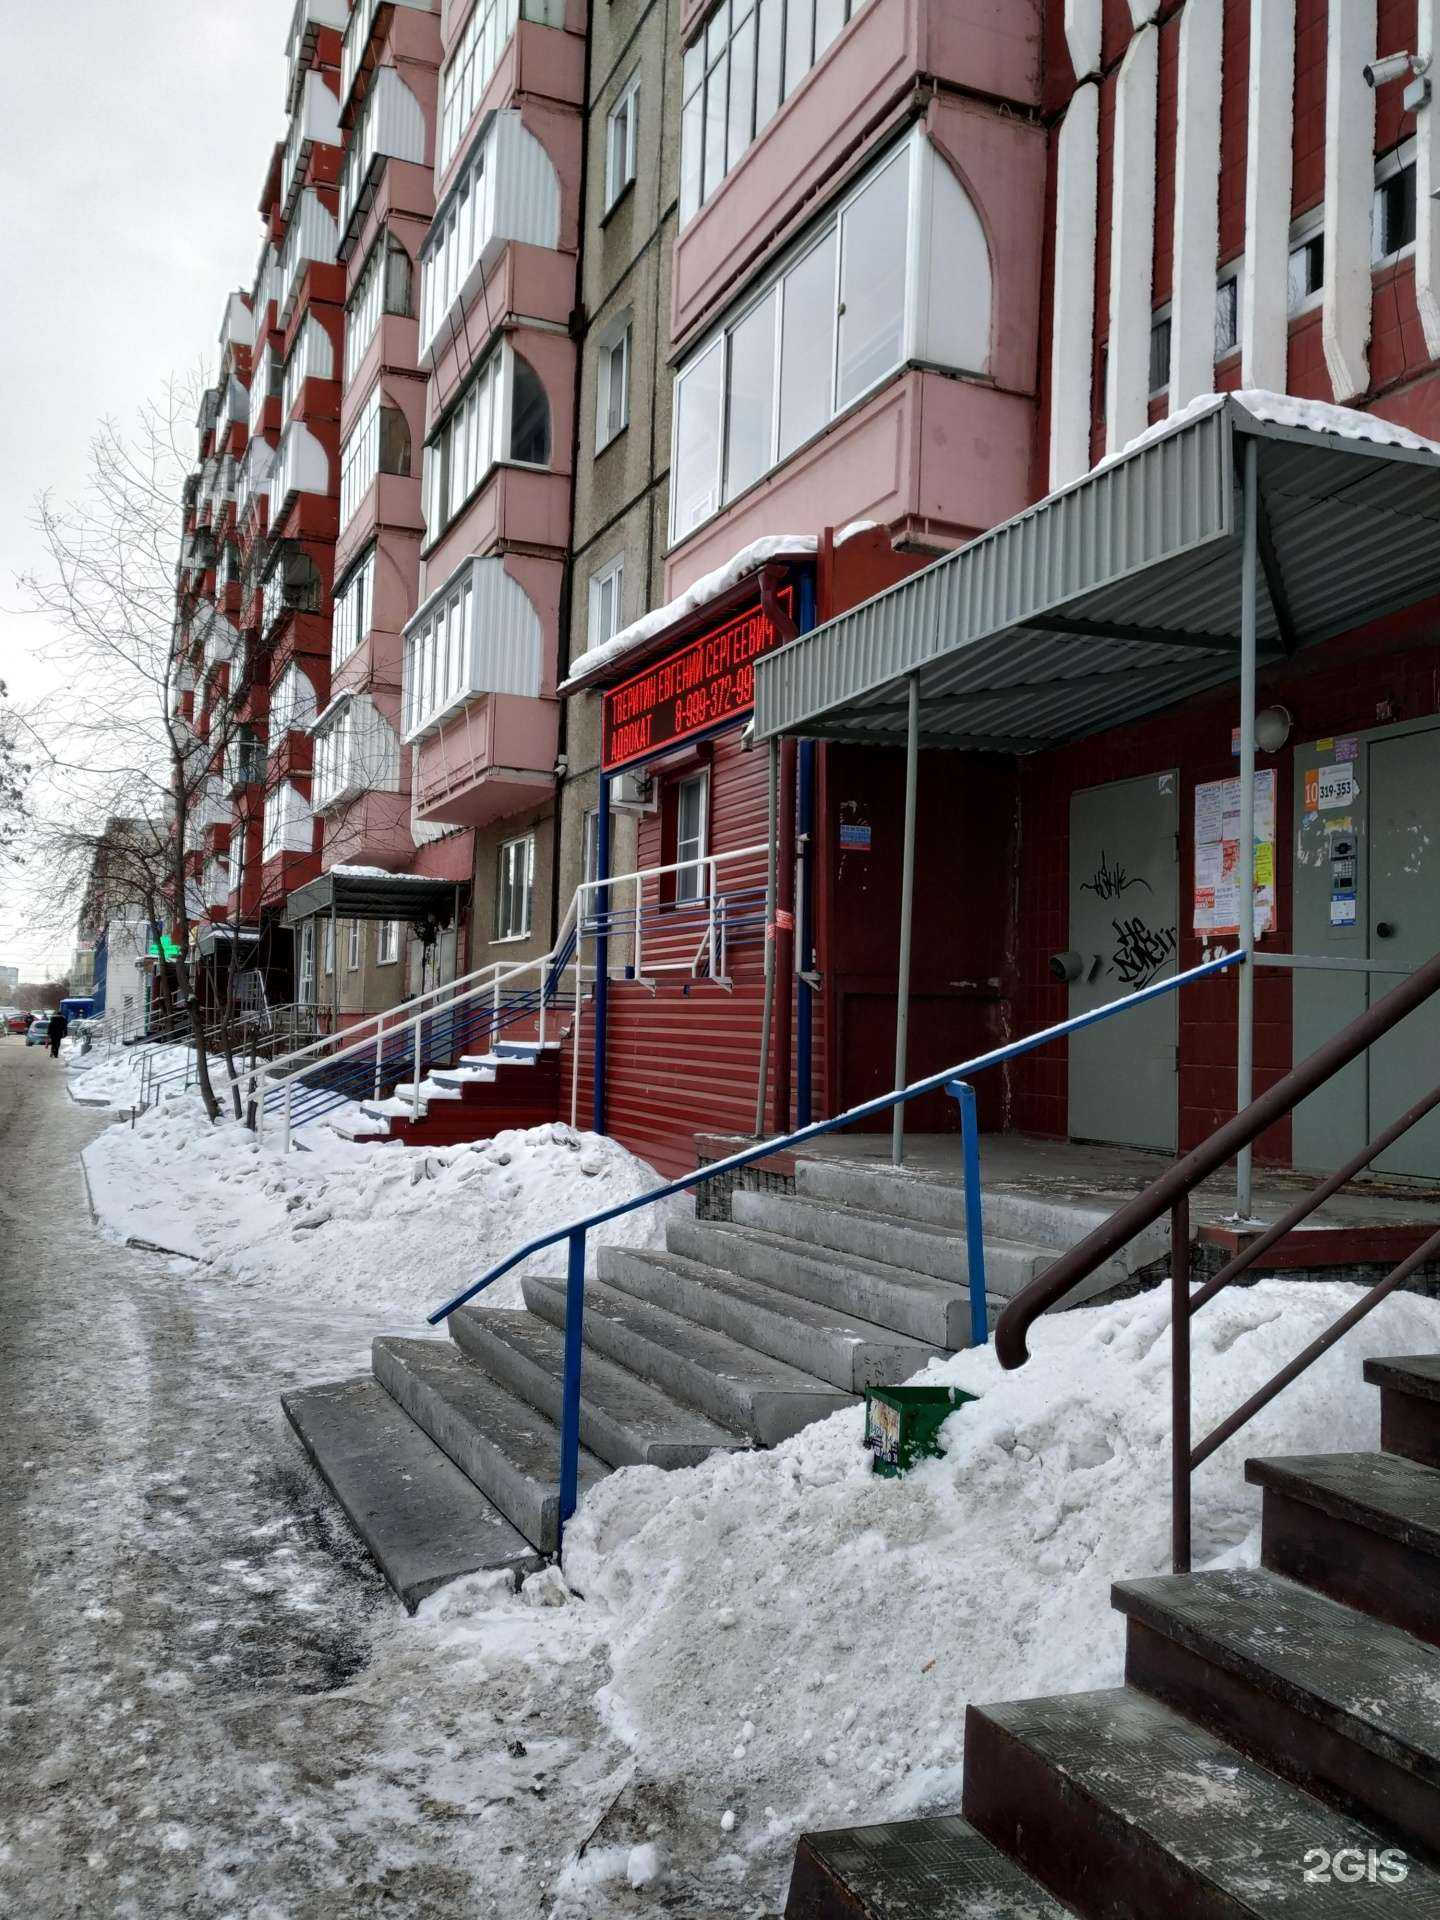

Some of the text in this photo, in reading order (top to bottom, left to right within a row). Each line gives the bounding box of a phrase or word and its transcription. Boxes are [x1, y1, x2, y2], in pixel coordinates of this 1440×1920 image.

[658, 645, 704, 703] ЕВГЕНИЙ
[705, 613, 773, 677] СЕРГЕЕВИЧ
[611, 714, 653, 761] АДВОКАТ
[1305, 782, 1318, 804] 10
[1320, 781, 1352, 799] 319-353
